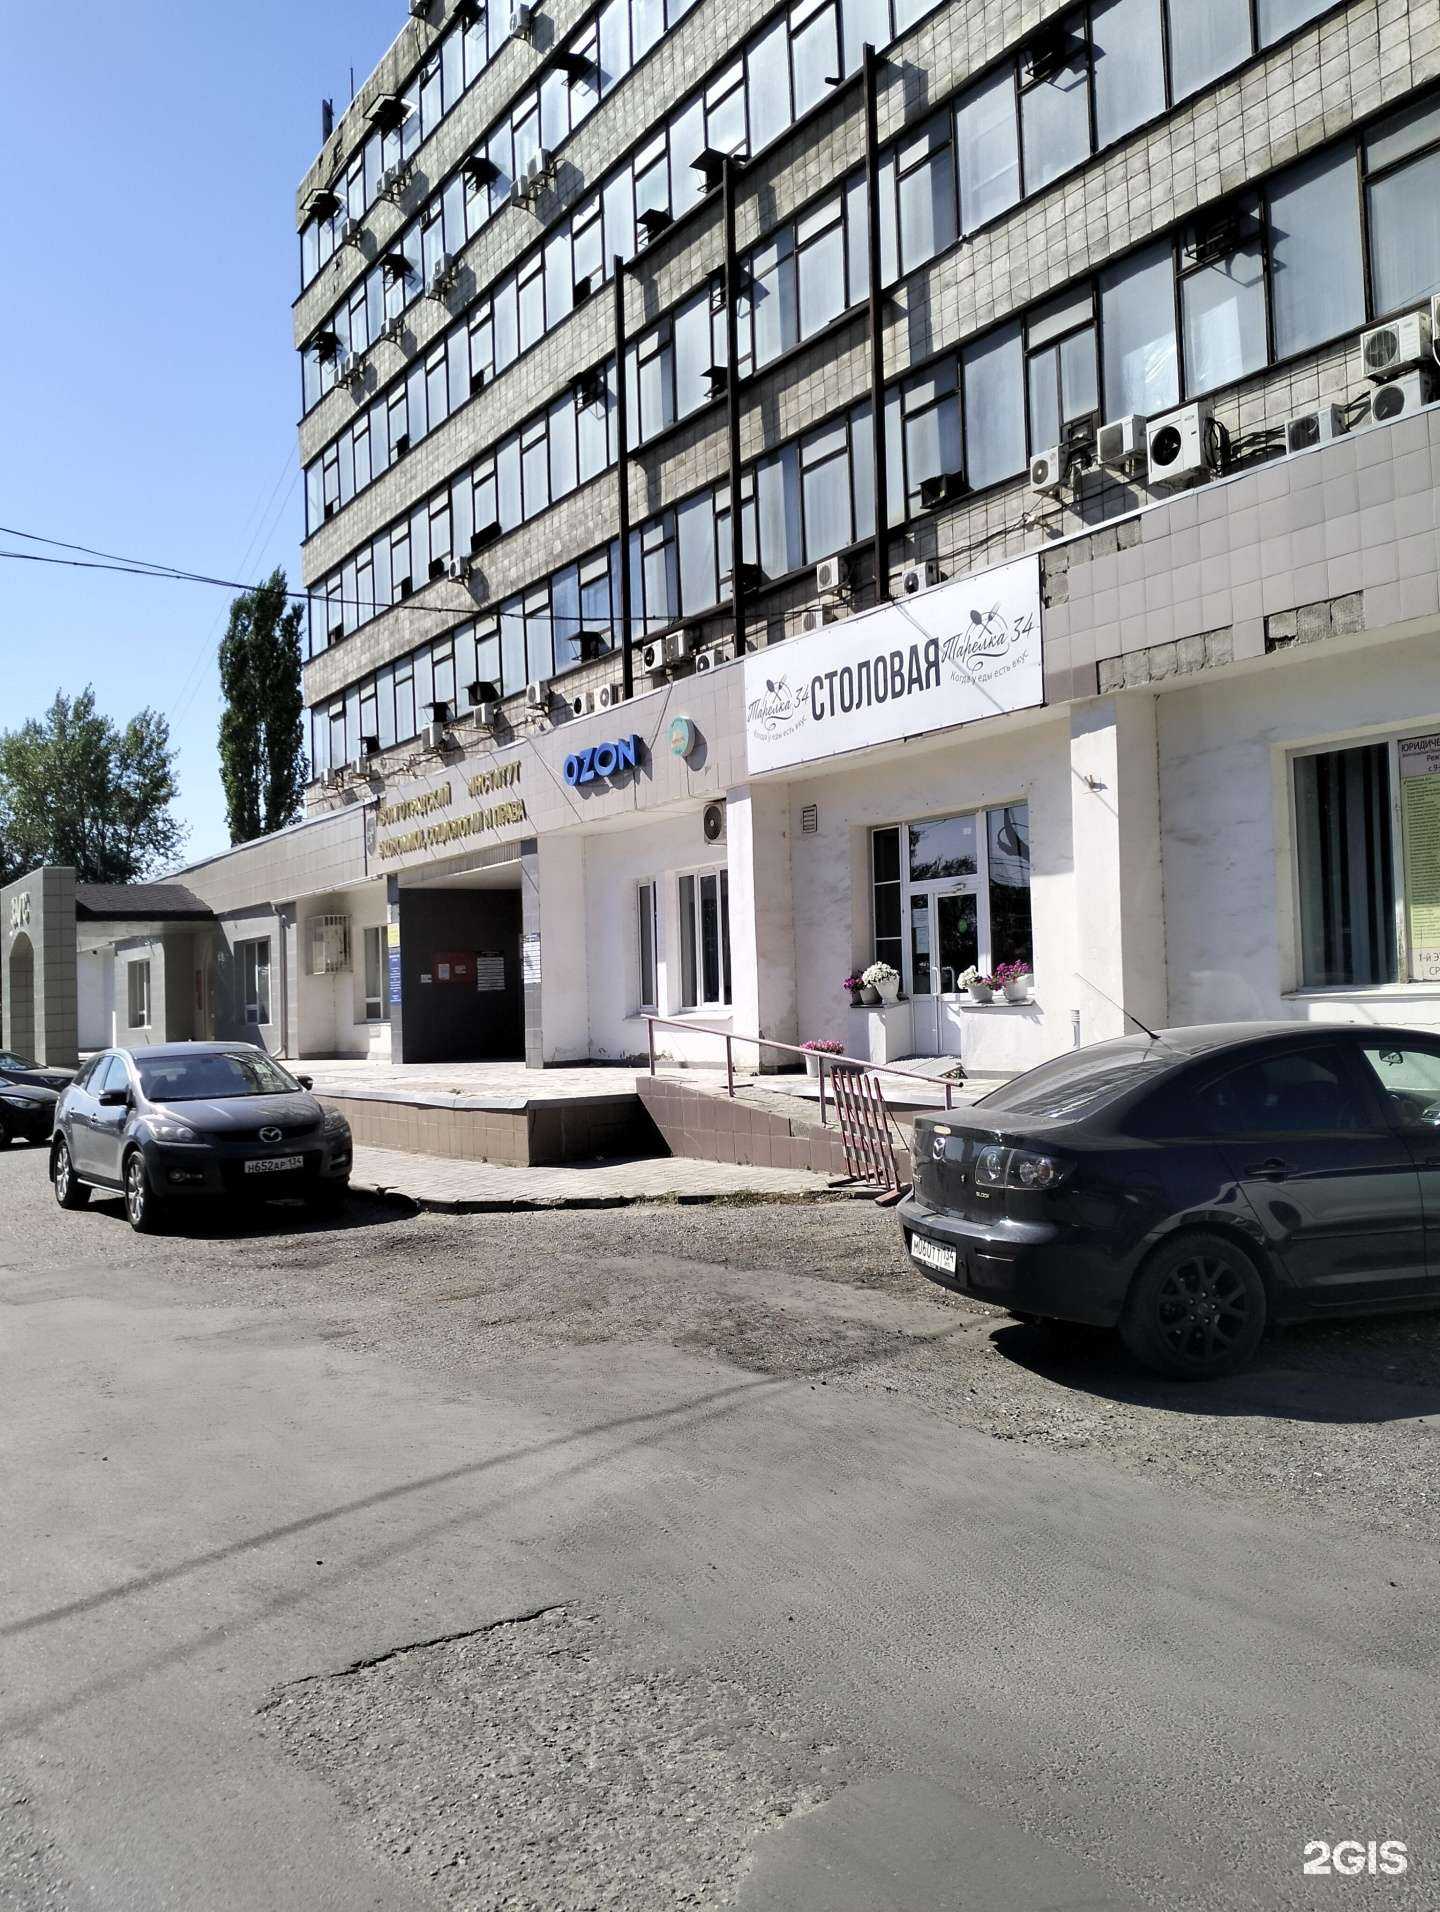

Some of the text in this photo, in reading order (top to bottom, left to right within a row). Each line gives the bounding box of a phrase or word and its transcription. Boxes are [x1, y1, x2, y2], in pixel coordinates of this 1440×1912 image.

[941, 612, 1034, 663] Тарелка 34
[794, 684, 809, 708] 34
[811, 637, 941, 721] СТОЛОВАЯ
[994, 665, 1011, 678] есть
[563, 735, 640, 786] OZON
